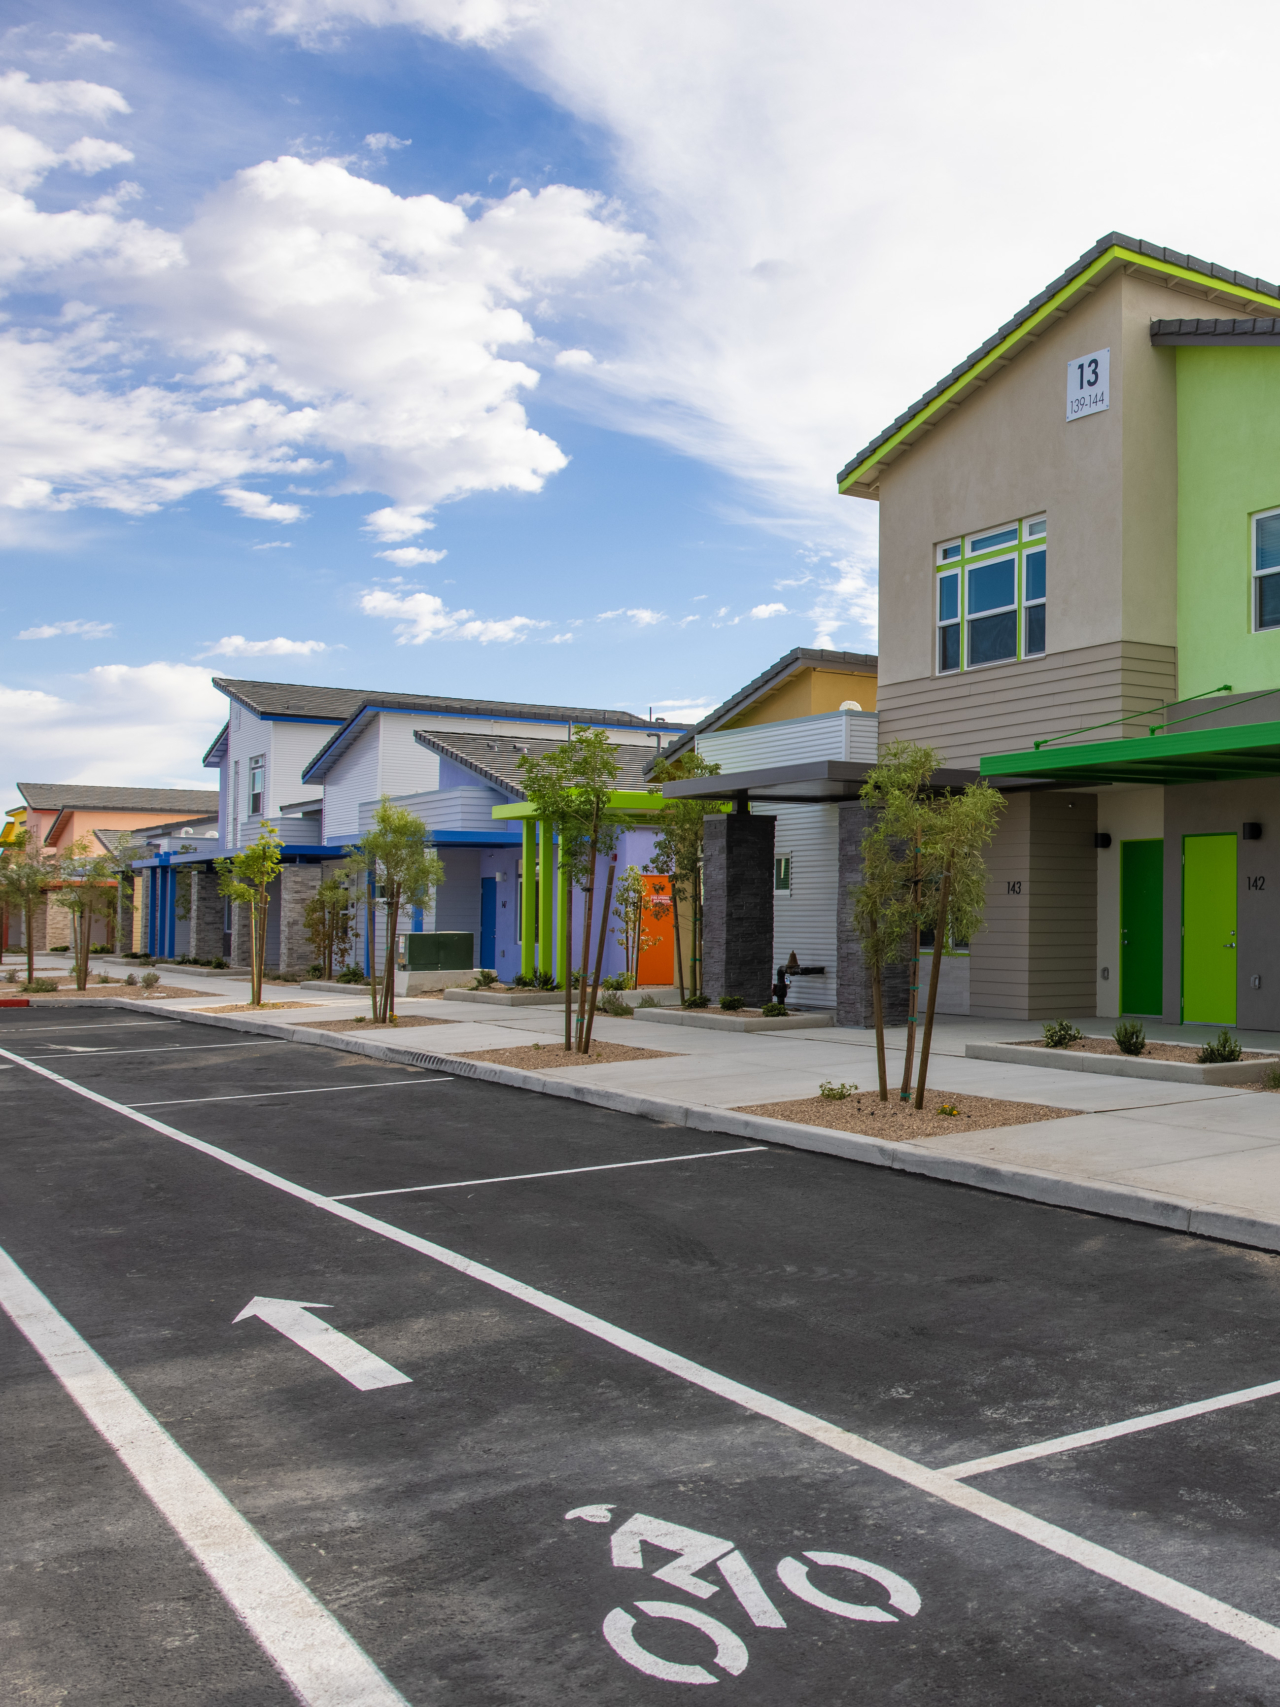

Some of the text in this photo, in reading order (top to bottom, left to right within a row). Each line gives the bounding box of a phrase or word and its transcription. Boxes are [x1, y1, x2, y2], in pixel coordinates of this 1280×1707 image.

[1077, 358, 1099, 390] 13
[1070, 391, 1104, 414] 139-144
[1007, 881, 1021, 895] 143
[1247, 876, 1265, 891] 142
